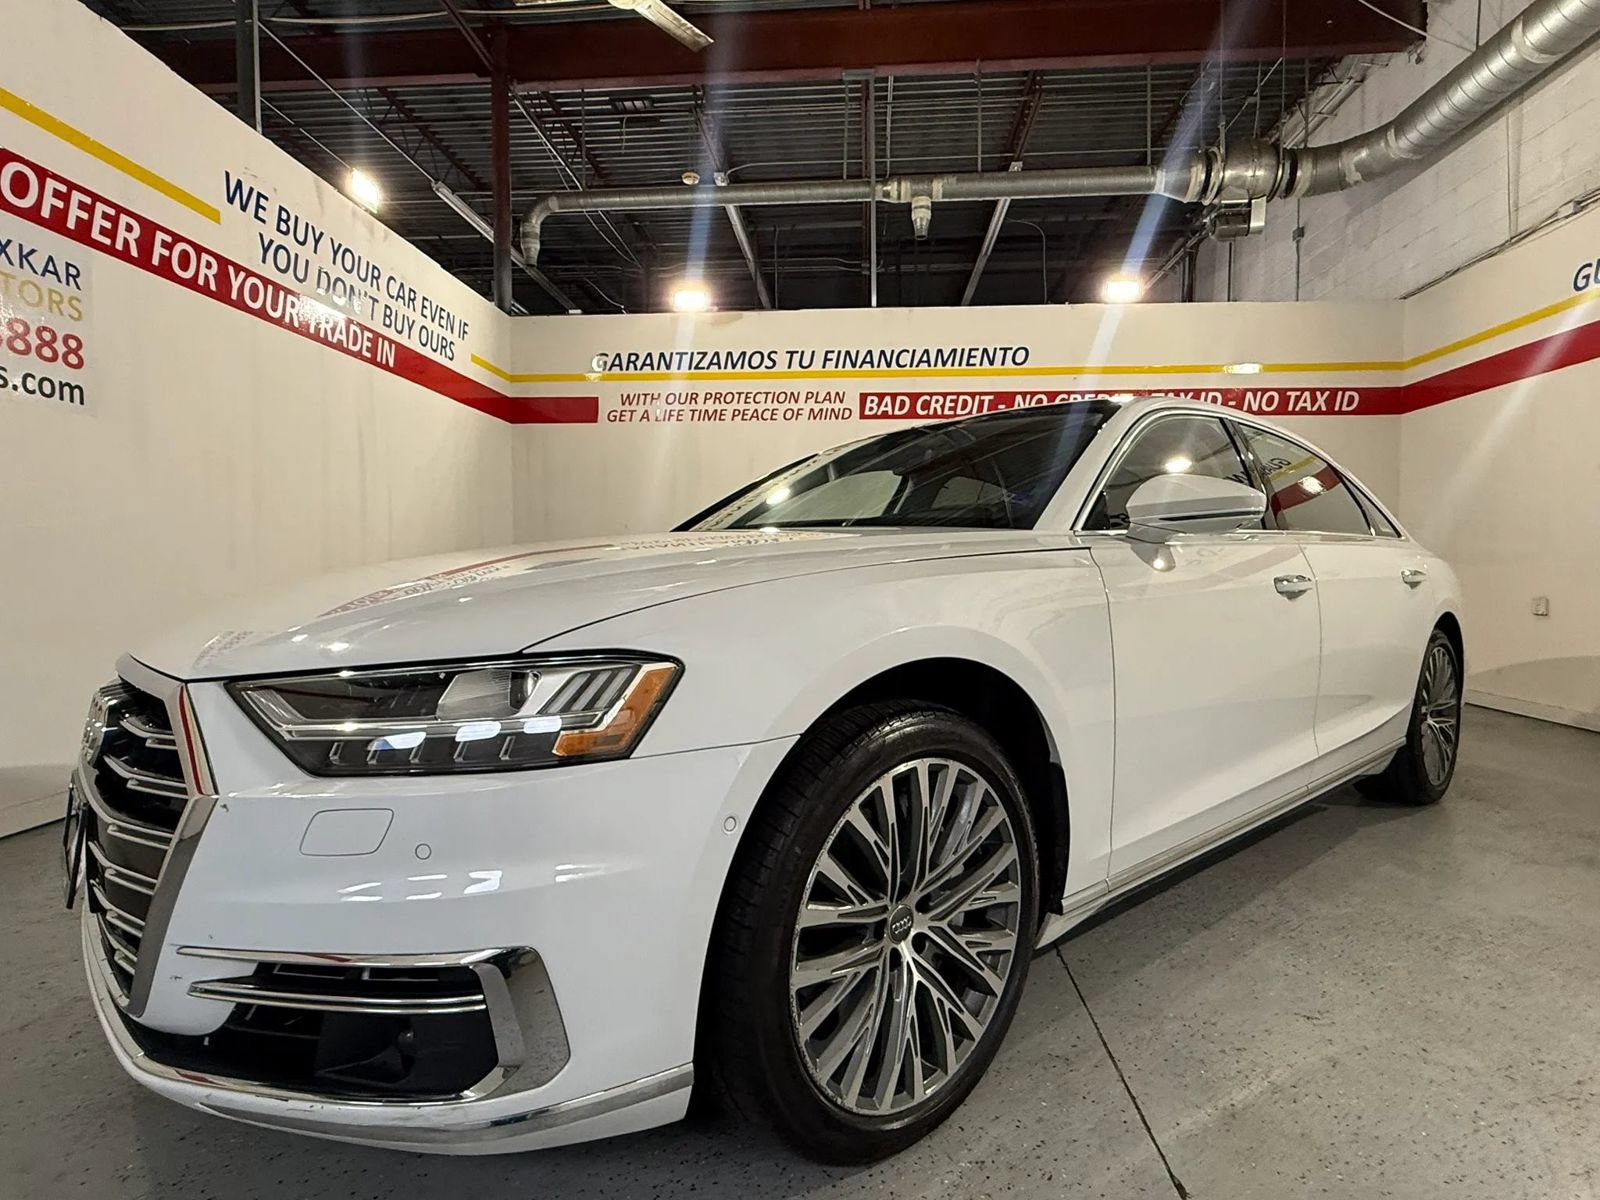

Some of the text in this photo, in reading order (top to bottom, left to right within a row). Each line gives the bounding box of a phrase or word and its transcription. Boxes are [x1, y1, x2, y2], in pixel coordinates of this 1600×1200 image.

[0, 161, 396, 368] OFFER FOR YOUR TRADE IN
[224, 170, 469, 341] WE BUY YOUR CAR EVEN IF
[258, 232, 455, 361] YOU DON'T BUY OURS
[0, 317, 85, 370] 888
[592, 346, 1030, 371] GARANTIZAMOS TU FINANCIAMIENTO
[607, 407, 853, 423] GET A LIFE TIME PEACE OF MIND
[620, 391, 846, 406] WITH OUR PROTECTION PLAN
[864, 395, 910, 416] BAD
[915, 394, 994, 415] CREDIT
[1243, 390, 1279, 412] NO
[1286, 390, 1330, 412] TAX
[1334, 390, 1360, 412] ID
